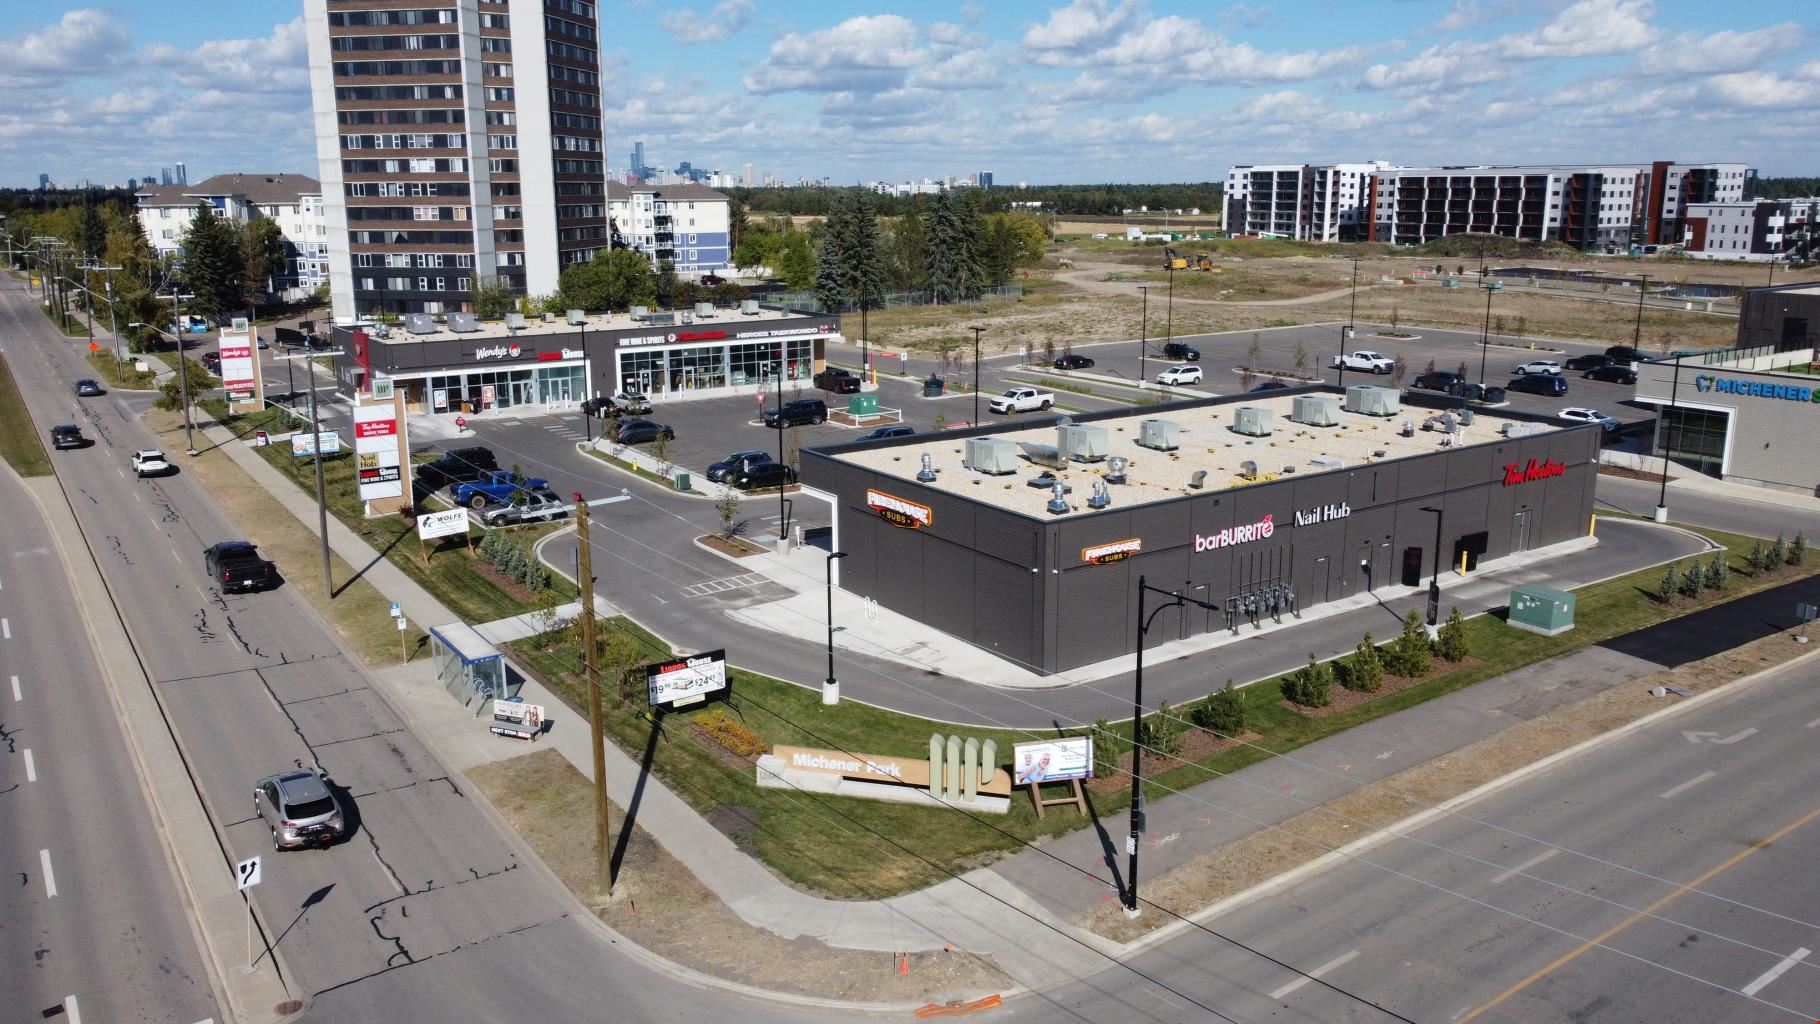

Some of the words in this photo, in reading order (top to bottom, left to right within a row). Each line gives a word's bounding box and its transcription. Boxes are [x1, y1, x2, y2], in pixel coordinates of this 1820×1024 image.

[476, 345, 507, 360] Wendy's
[1716, 378, 1811, 402] MICHENER
[1503, 463, 1525, 486] Tim
[1525, 459, 1565, 482] Hortons
[437, 512, 463, 521] WOLFE
[886, 511, 906, 524] SUBS
[1295, 506, 1320, 527] Nail
[1324, 501, 1350, 521] Hub
[1105, 553, 1123, 562] SUBS
[793, 753, 862, 773] Michener
[866, 760, 901, 777] Park
